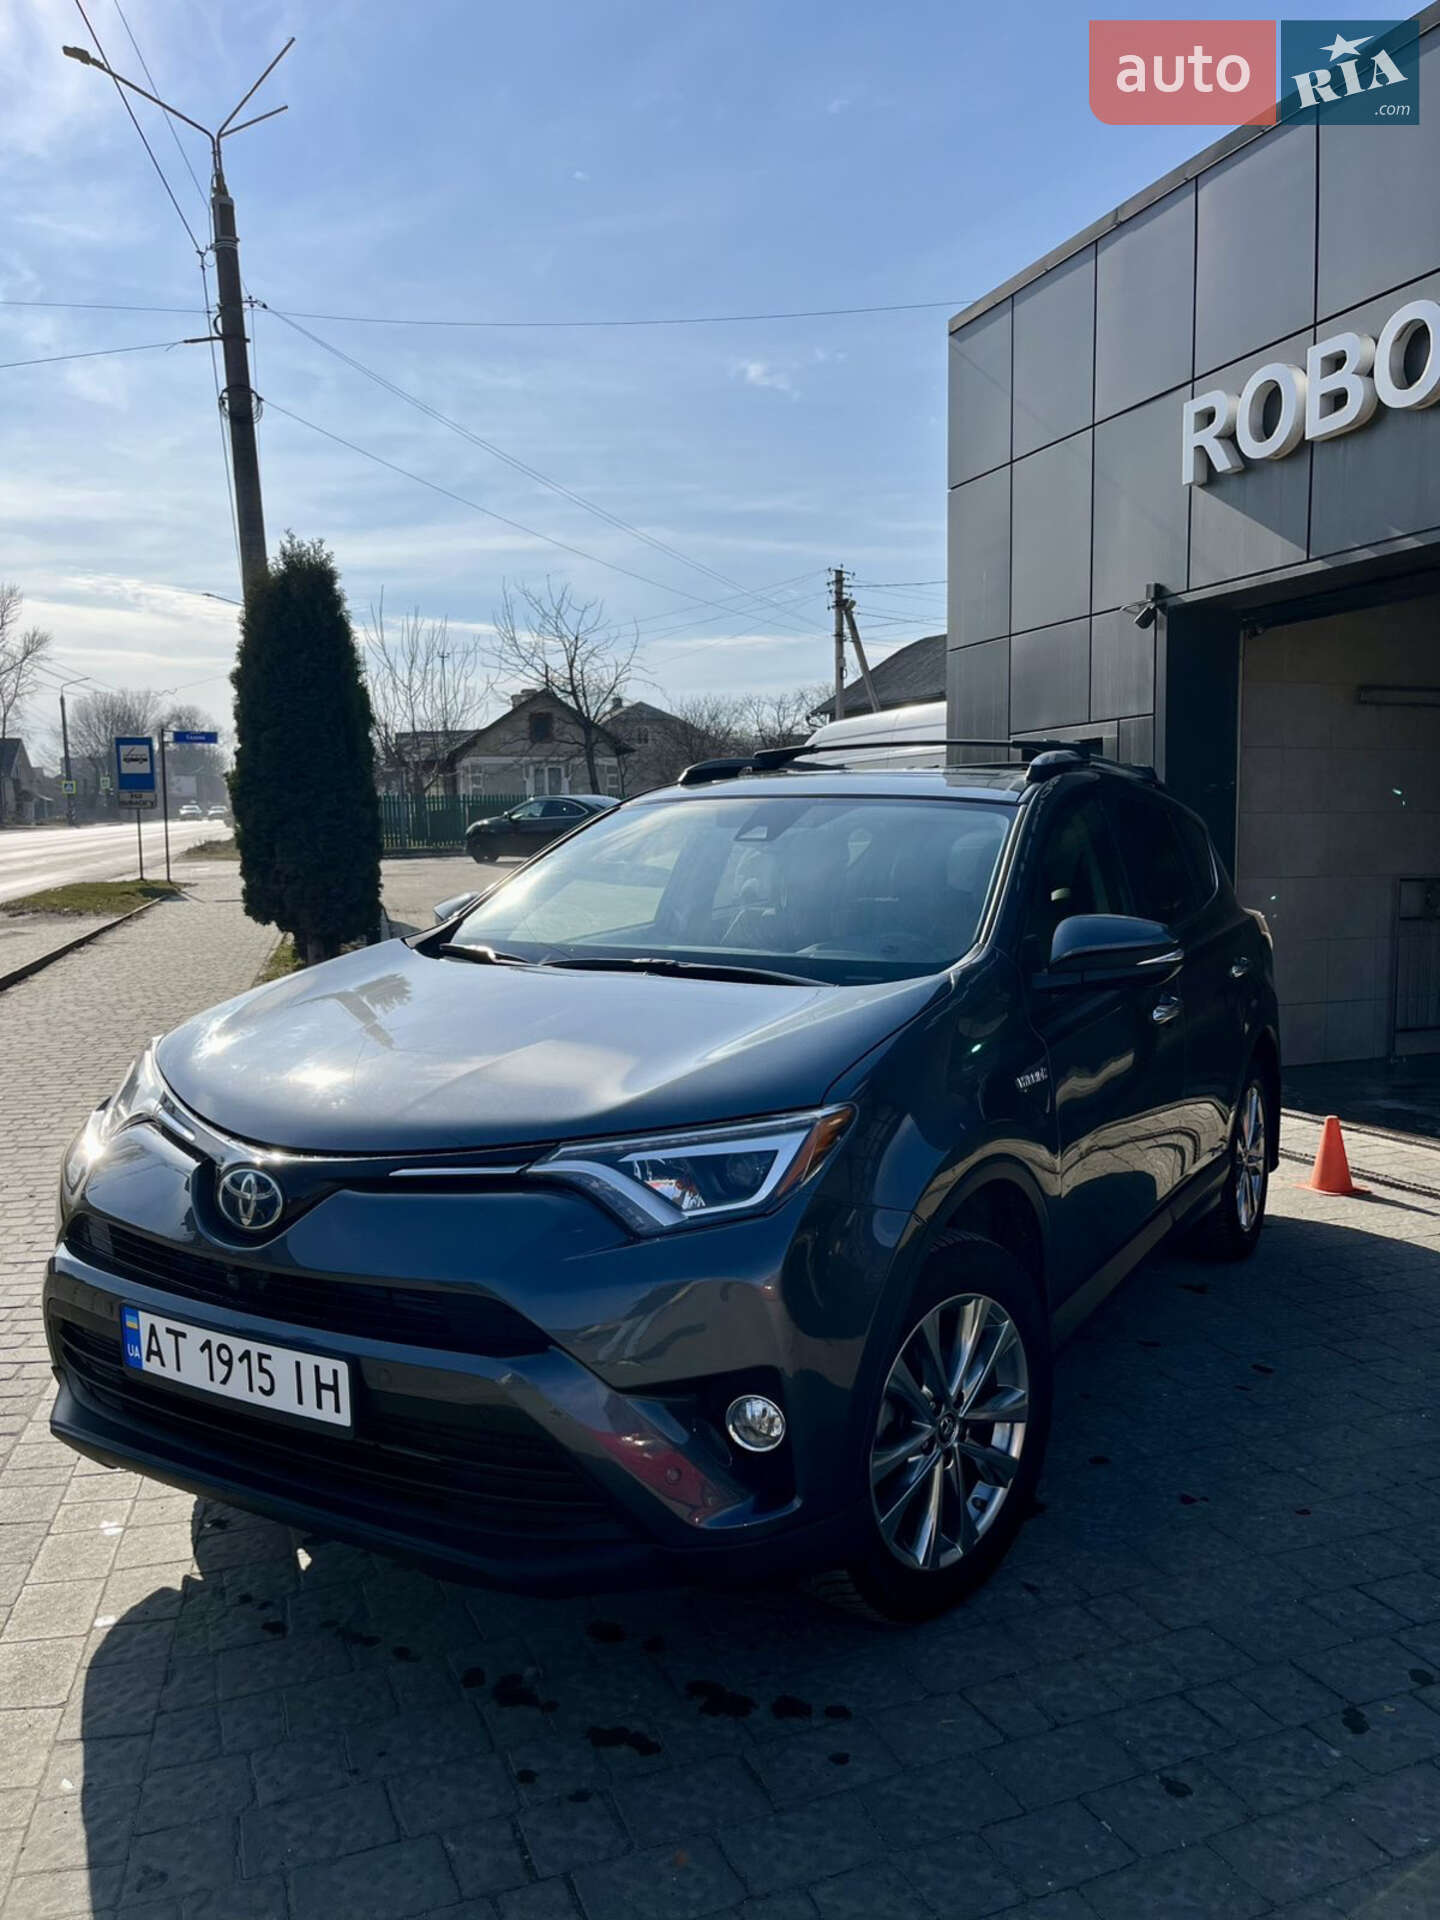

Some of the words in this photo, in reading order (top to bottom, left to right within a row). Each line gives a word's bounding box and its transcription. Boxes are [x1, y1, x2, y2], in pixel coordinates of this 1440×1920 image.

[1182, 299, 1440, 486] ROBO
[127, 1342, 141, 1360] UA
[145, 1323, 188, 1372] AT
[199, 1339, 276, 1397] 1915
[294, 1360, 341, 1414] IH
